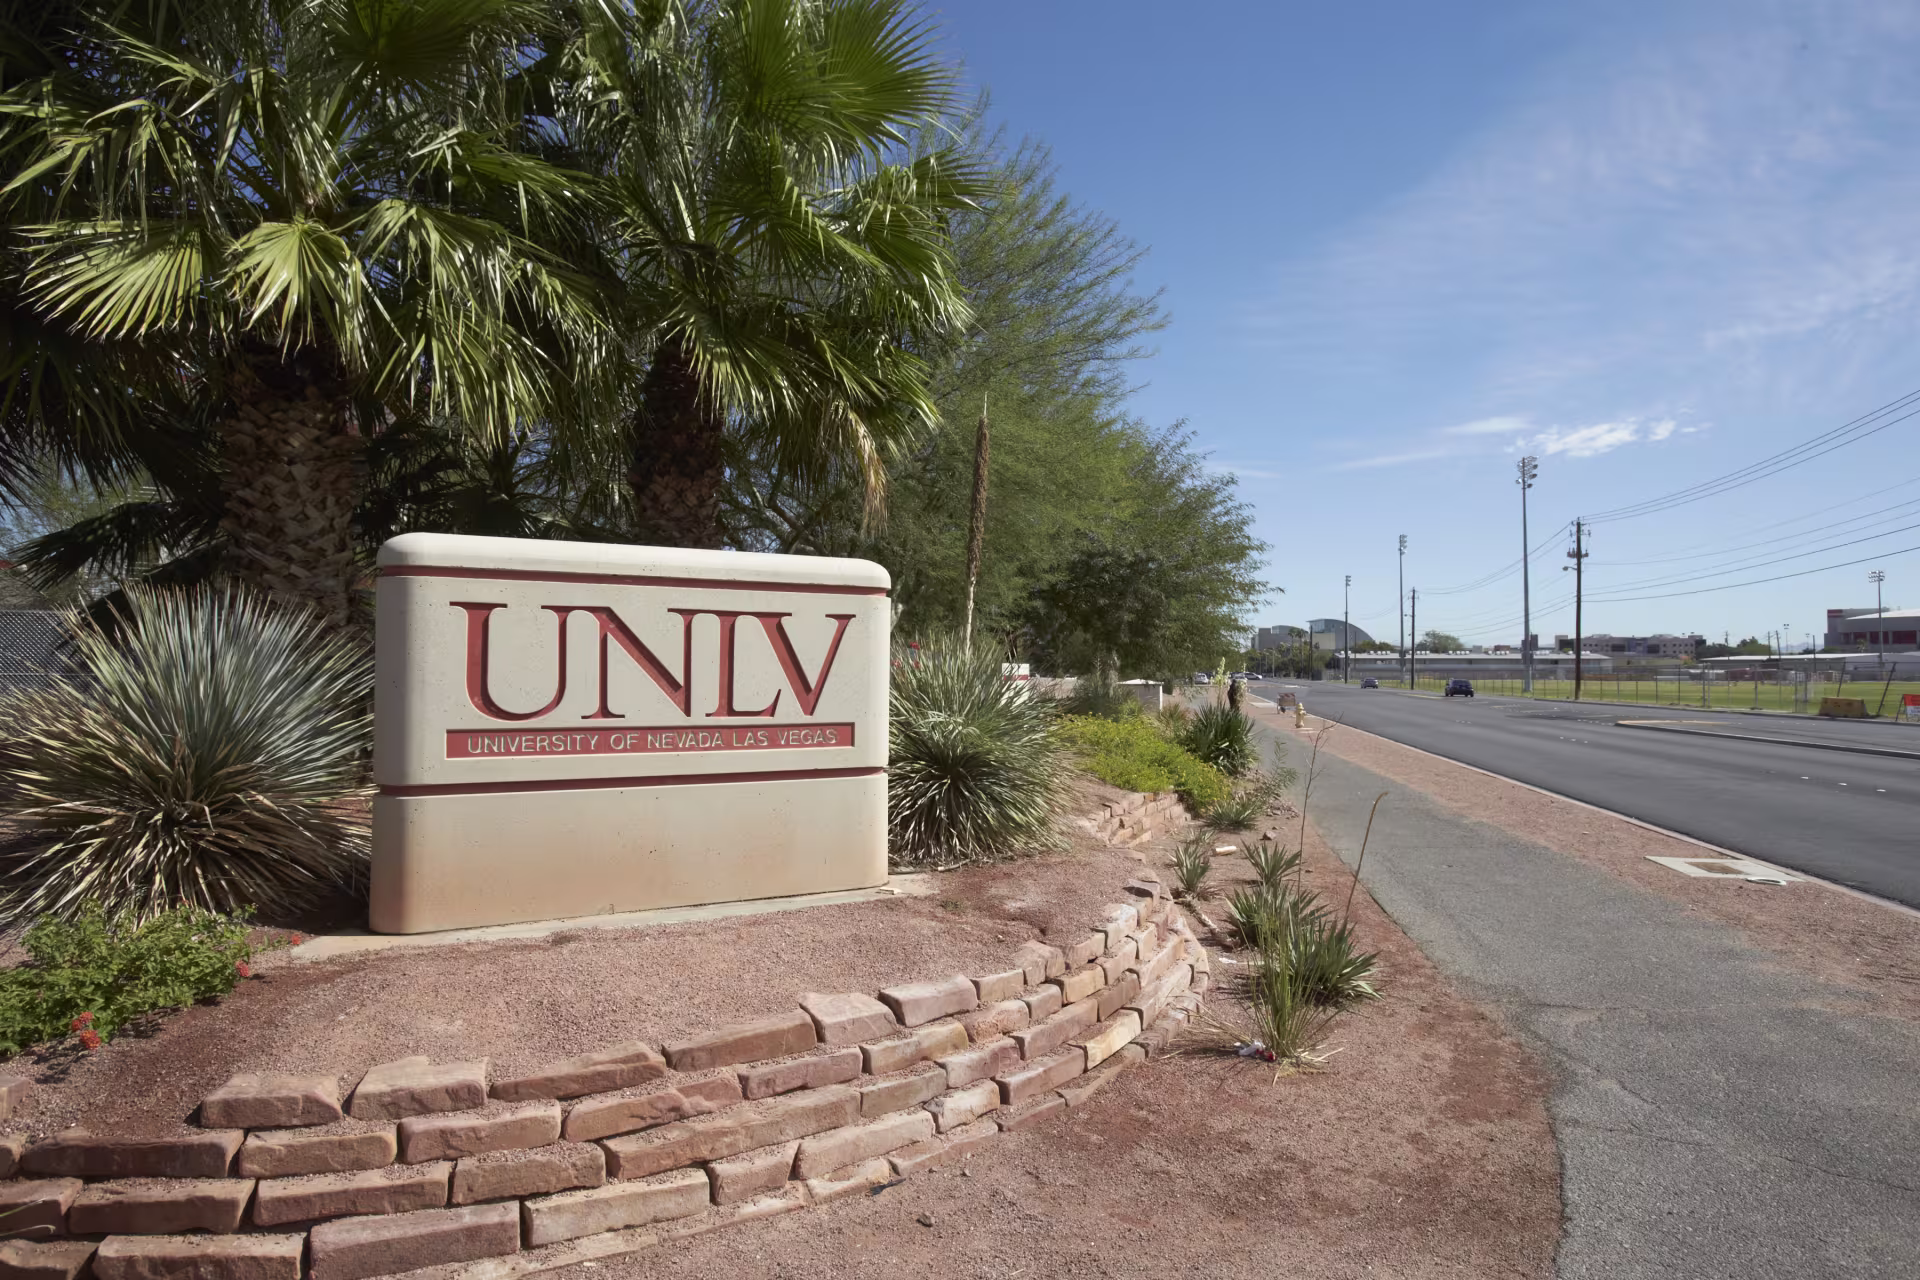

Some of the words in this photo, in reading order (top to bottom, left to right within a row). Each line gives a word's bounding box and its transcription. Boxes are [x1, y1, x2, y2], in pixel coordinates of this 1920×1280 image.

[449, 600, 857, 722] UNLV
[467, 734, 599, 754] UNIVERSITY
[610, 733, 640, 750] OF
[646, 731, 725, 749] NEVADA
[732, 730, 769, 747] LAS
[777, 728, 838, 746] VEGAS
